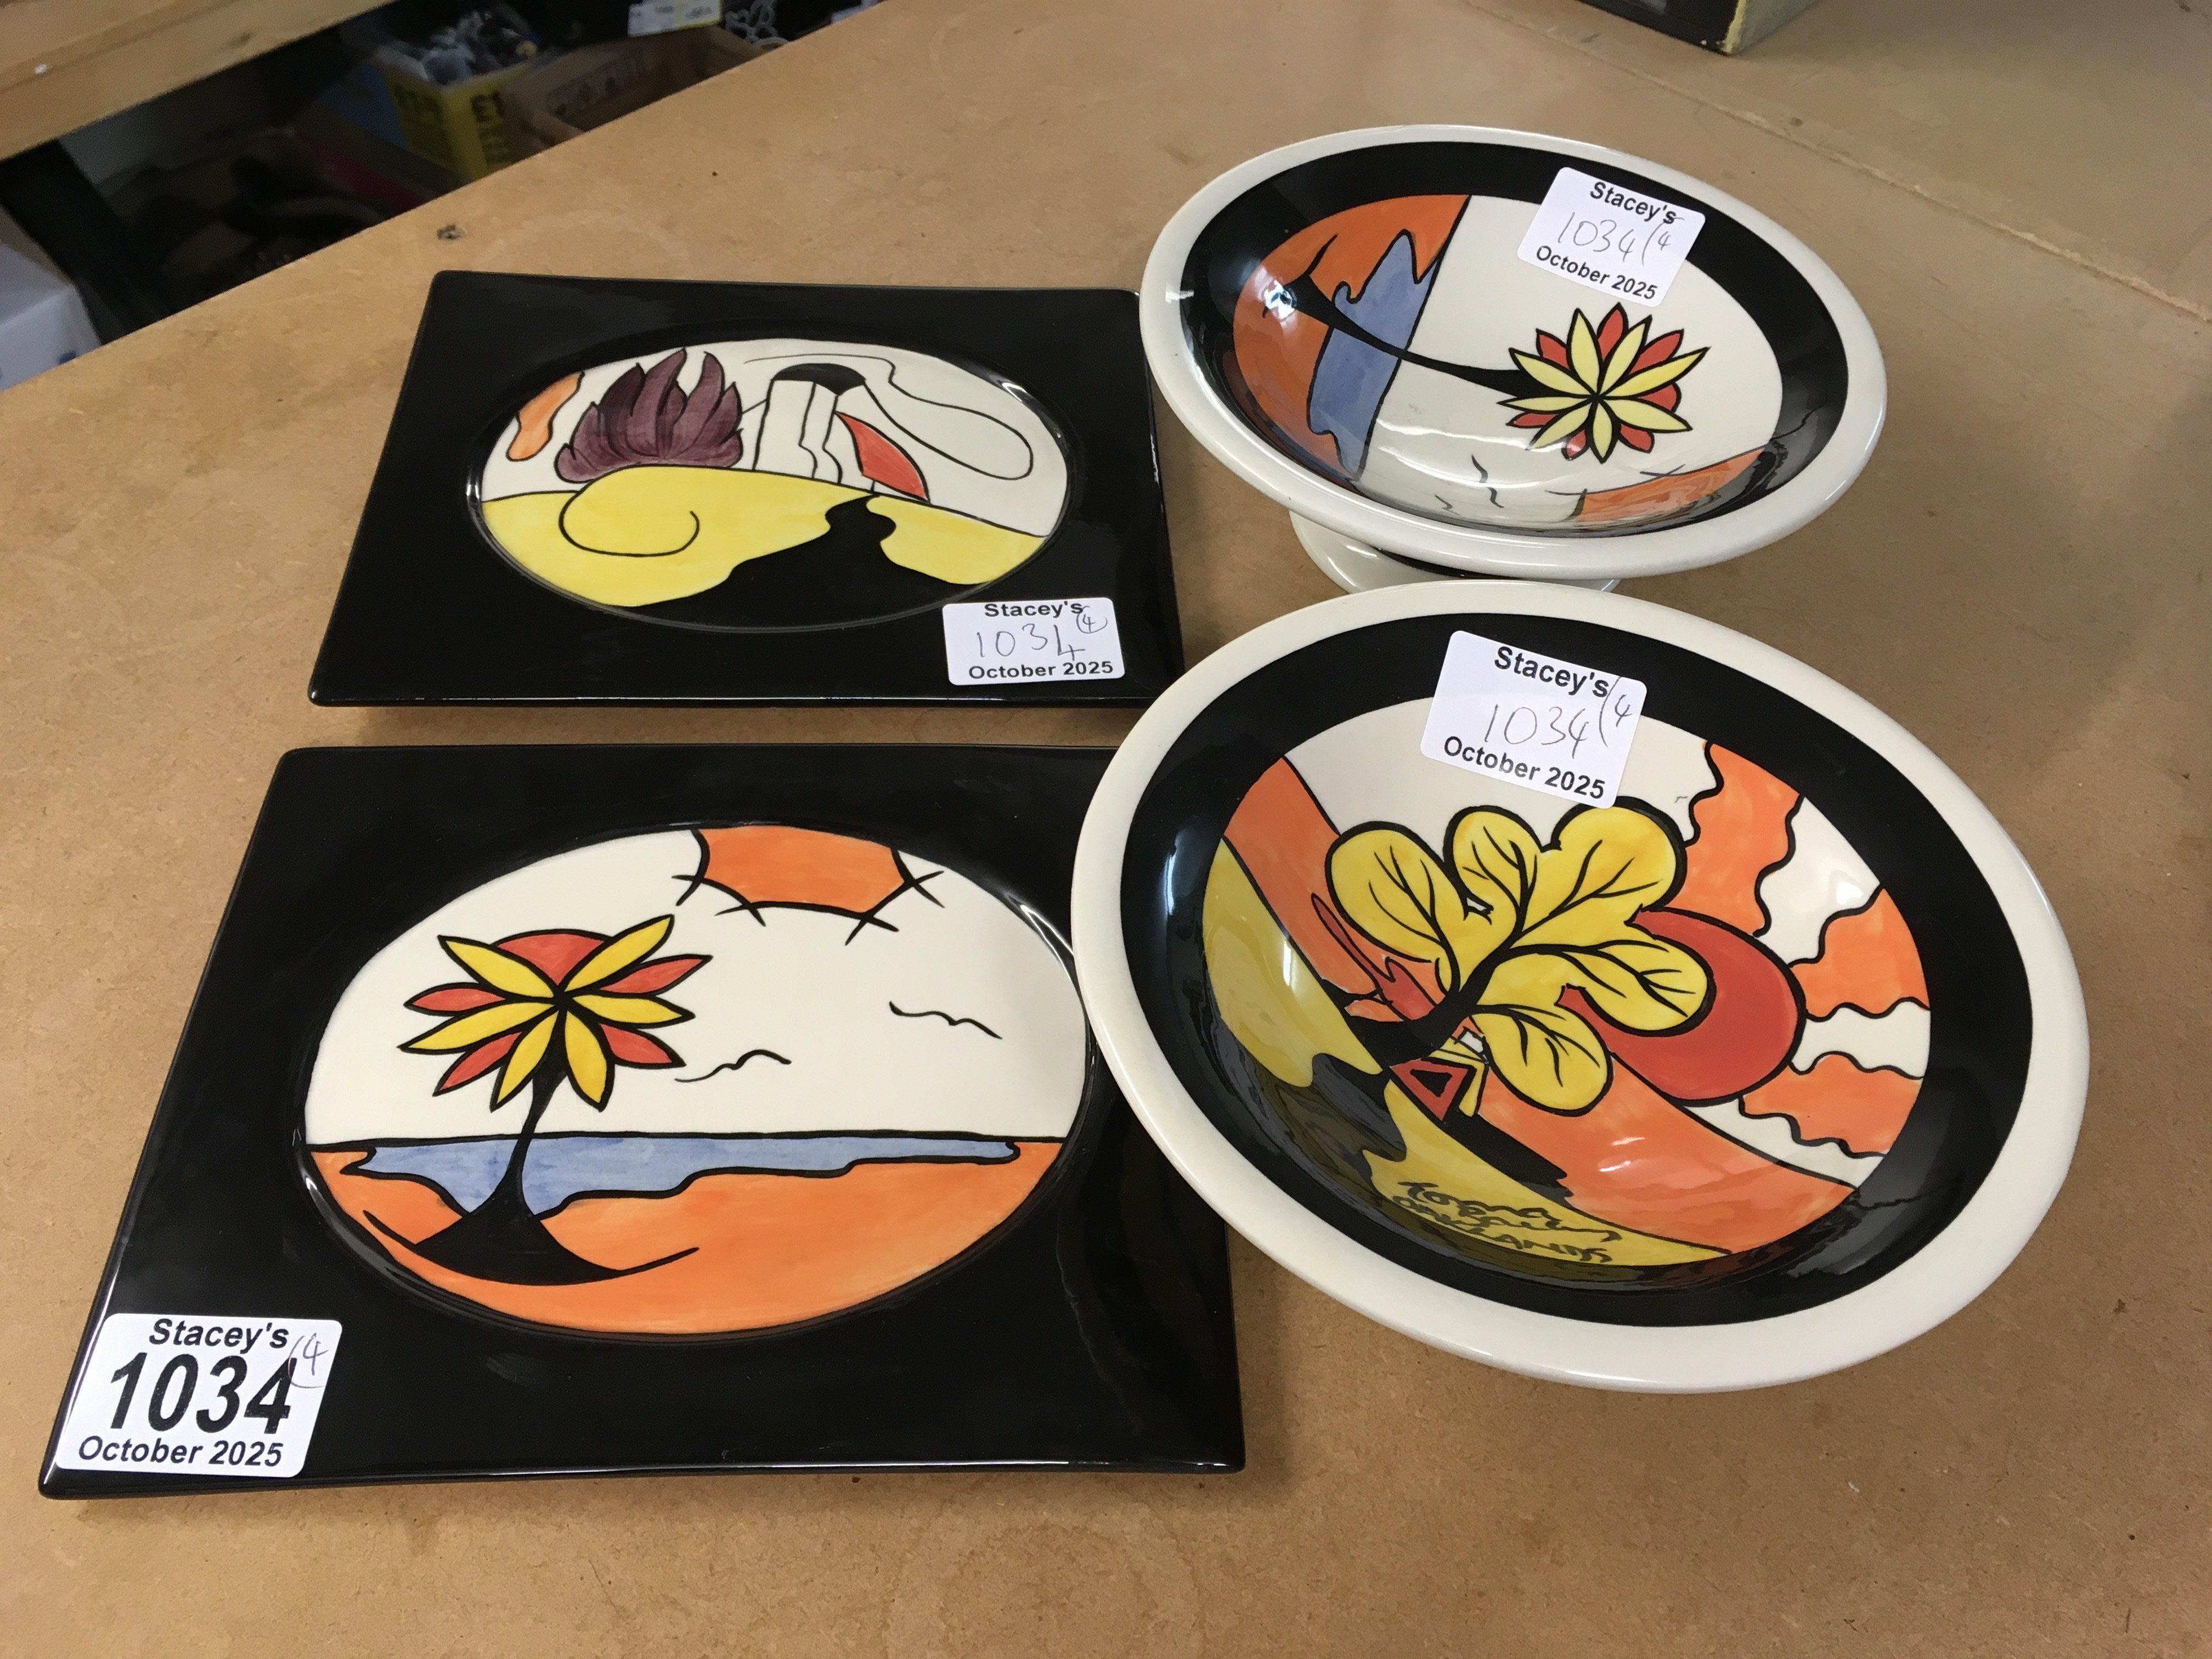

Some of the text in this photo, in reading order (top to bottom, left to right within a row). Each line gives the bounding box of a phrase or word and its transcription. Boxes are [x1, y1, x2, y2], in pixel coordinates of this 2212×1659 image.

[1589, 181, 1677, 224] Stacey's
[1558, 211, 1635, 263] 1034
[1536, 245, 1658, 300] October 2025
[984, 601, 1084, 618] Stacey's
[977, 623, 1086, 662] 1034
[968, 661, 1114, 680] October 2025
[1494, 646, 1610, 698] Stacey's
[1484, 704, 1589, 759] 1034
[1444, 735, 1606, 799] October 2025
[149, 1318, 290, 1355] Stacey's
[109, 1352, 297, 1435] 1034
[78, 1435, 284, 1467] October 2025
